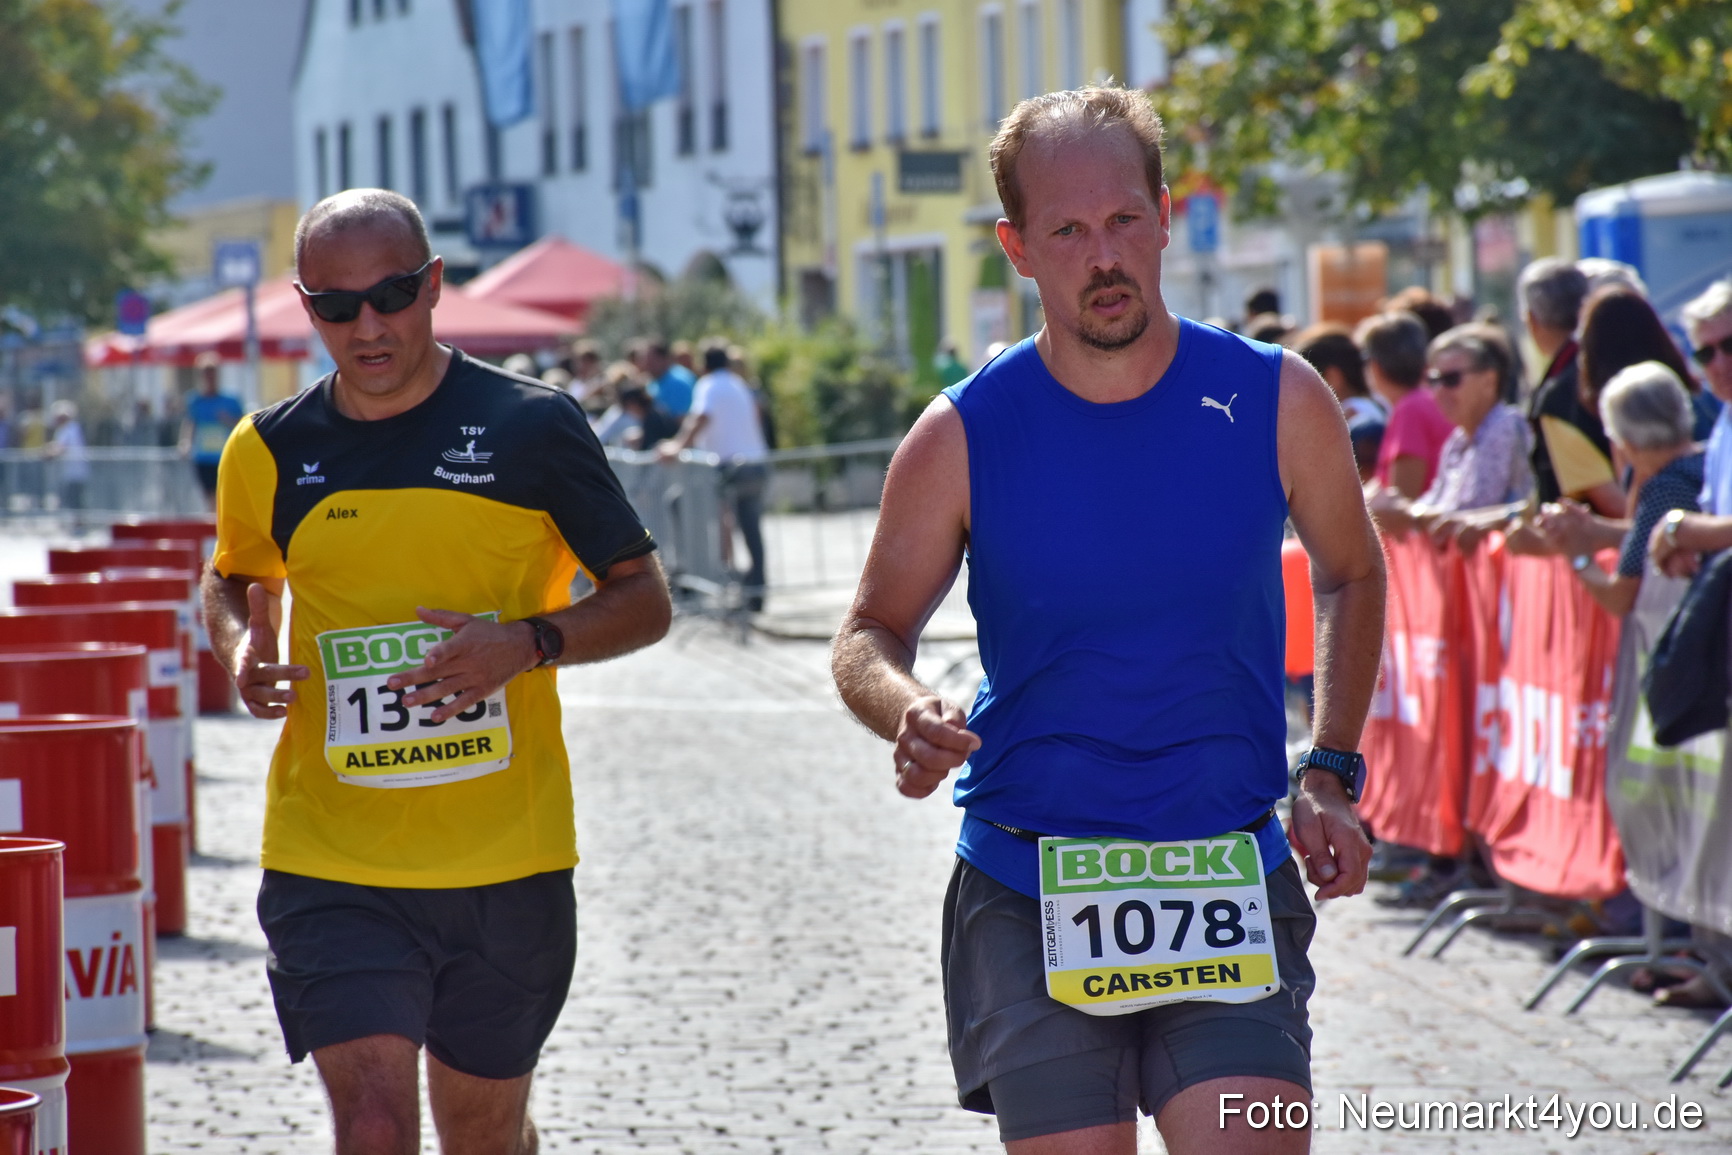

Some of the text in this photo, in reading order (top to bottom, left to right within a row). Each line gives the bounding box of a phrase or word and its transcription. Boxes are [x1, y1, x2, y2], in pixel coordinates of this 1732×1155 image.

[460, 426, 486, 436] TSV
[296, 474, 325, 486] erima
[433, 465, 496, 485] Burgthann
[326, 507, 358, 521] Alex
[332, 628, 455, 673] BOC
[345, 736, 493, 769] ALEXANDER
[1057, 840, 1244, 887] BOCK
[1247, 901, 1258, 912] A
[1071, 899, 1246, 959] 1078
[1083, 963, 1241, 998] CARSTEN
